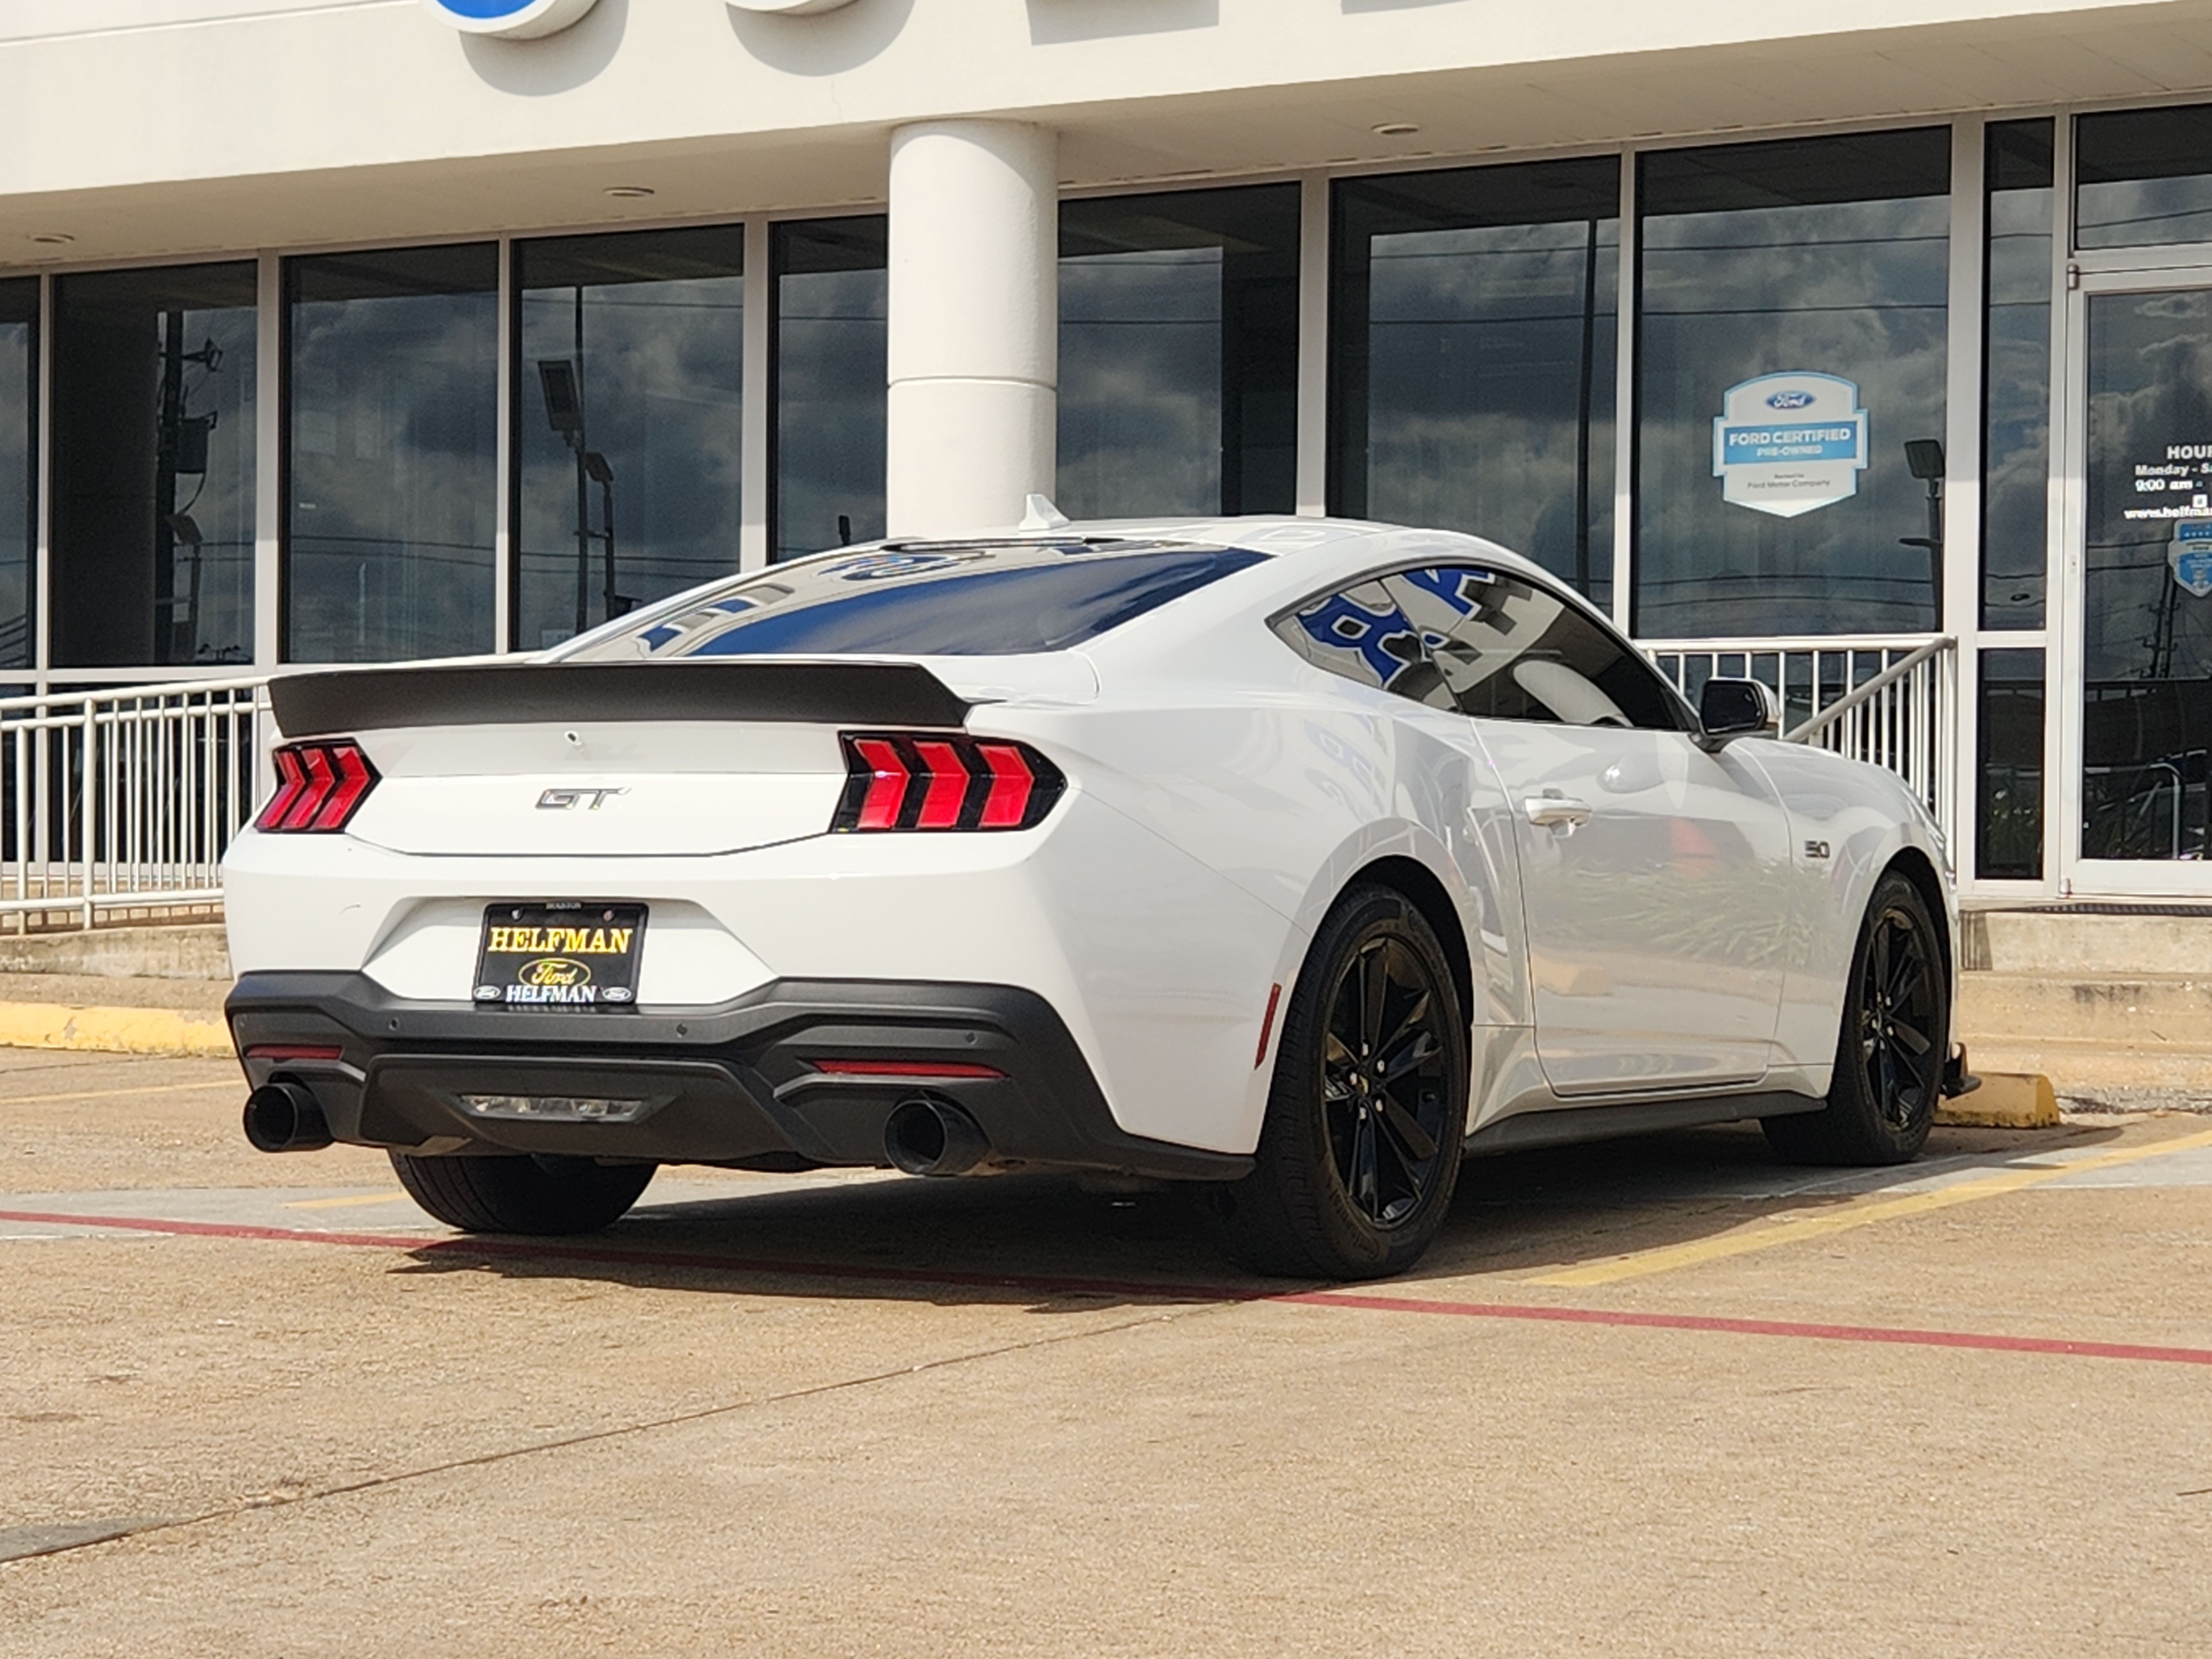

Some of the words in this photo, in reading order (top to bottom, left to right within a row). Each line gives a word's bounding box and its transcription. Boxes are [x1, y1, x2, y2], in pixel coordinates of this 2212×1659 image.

[1729, 432, 1770, 446] FORD
[1773, 428, 1851, 443] CERTIFIED
[1756, 445, 1823, 457] PRE-OWNED
[2135, 464, 2190, 477] Monday
[535, 787, 631, 810] GT
[488, 927, 634, 954] HELFMAN
[506, 985, 598, 1002] HELFMAN
